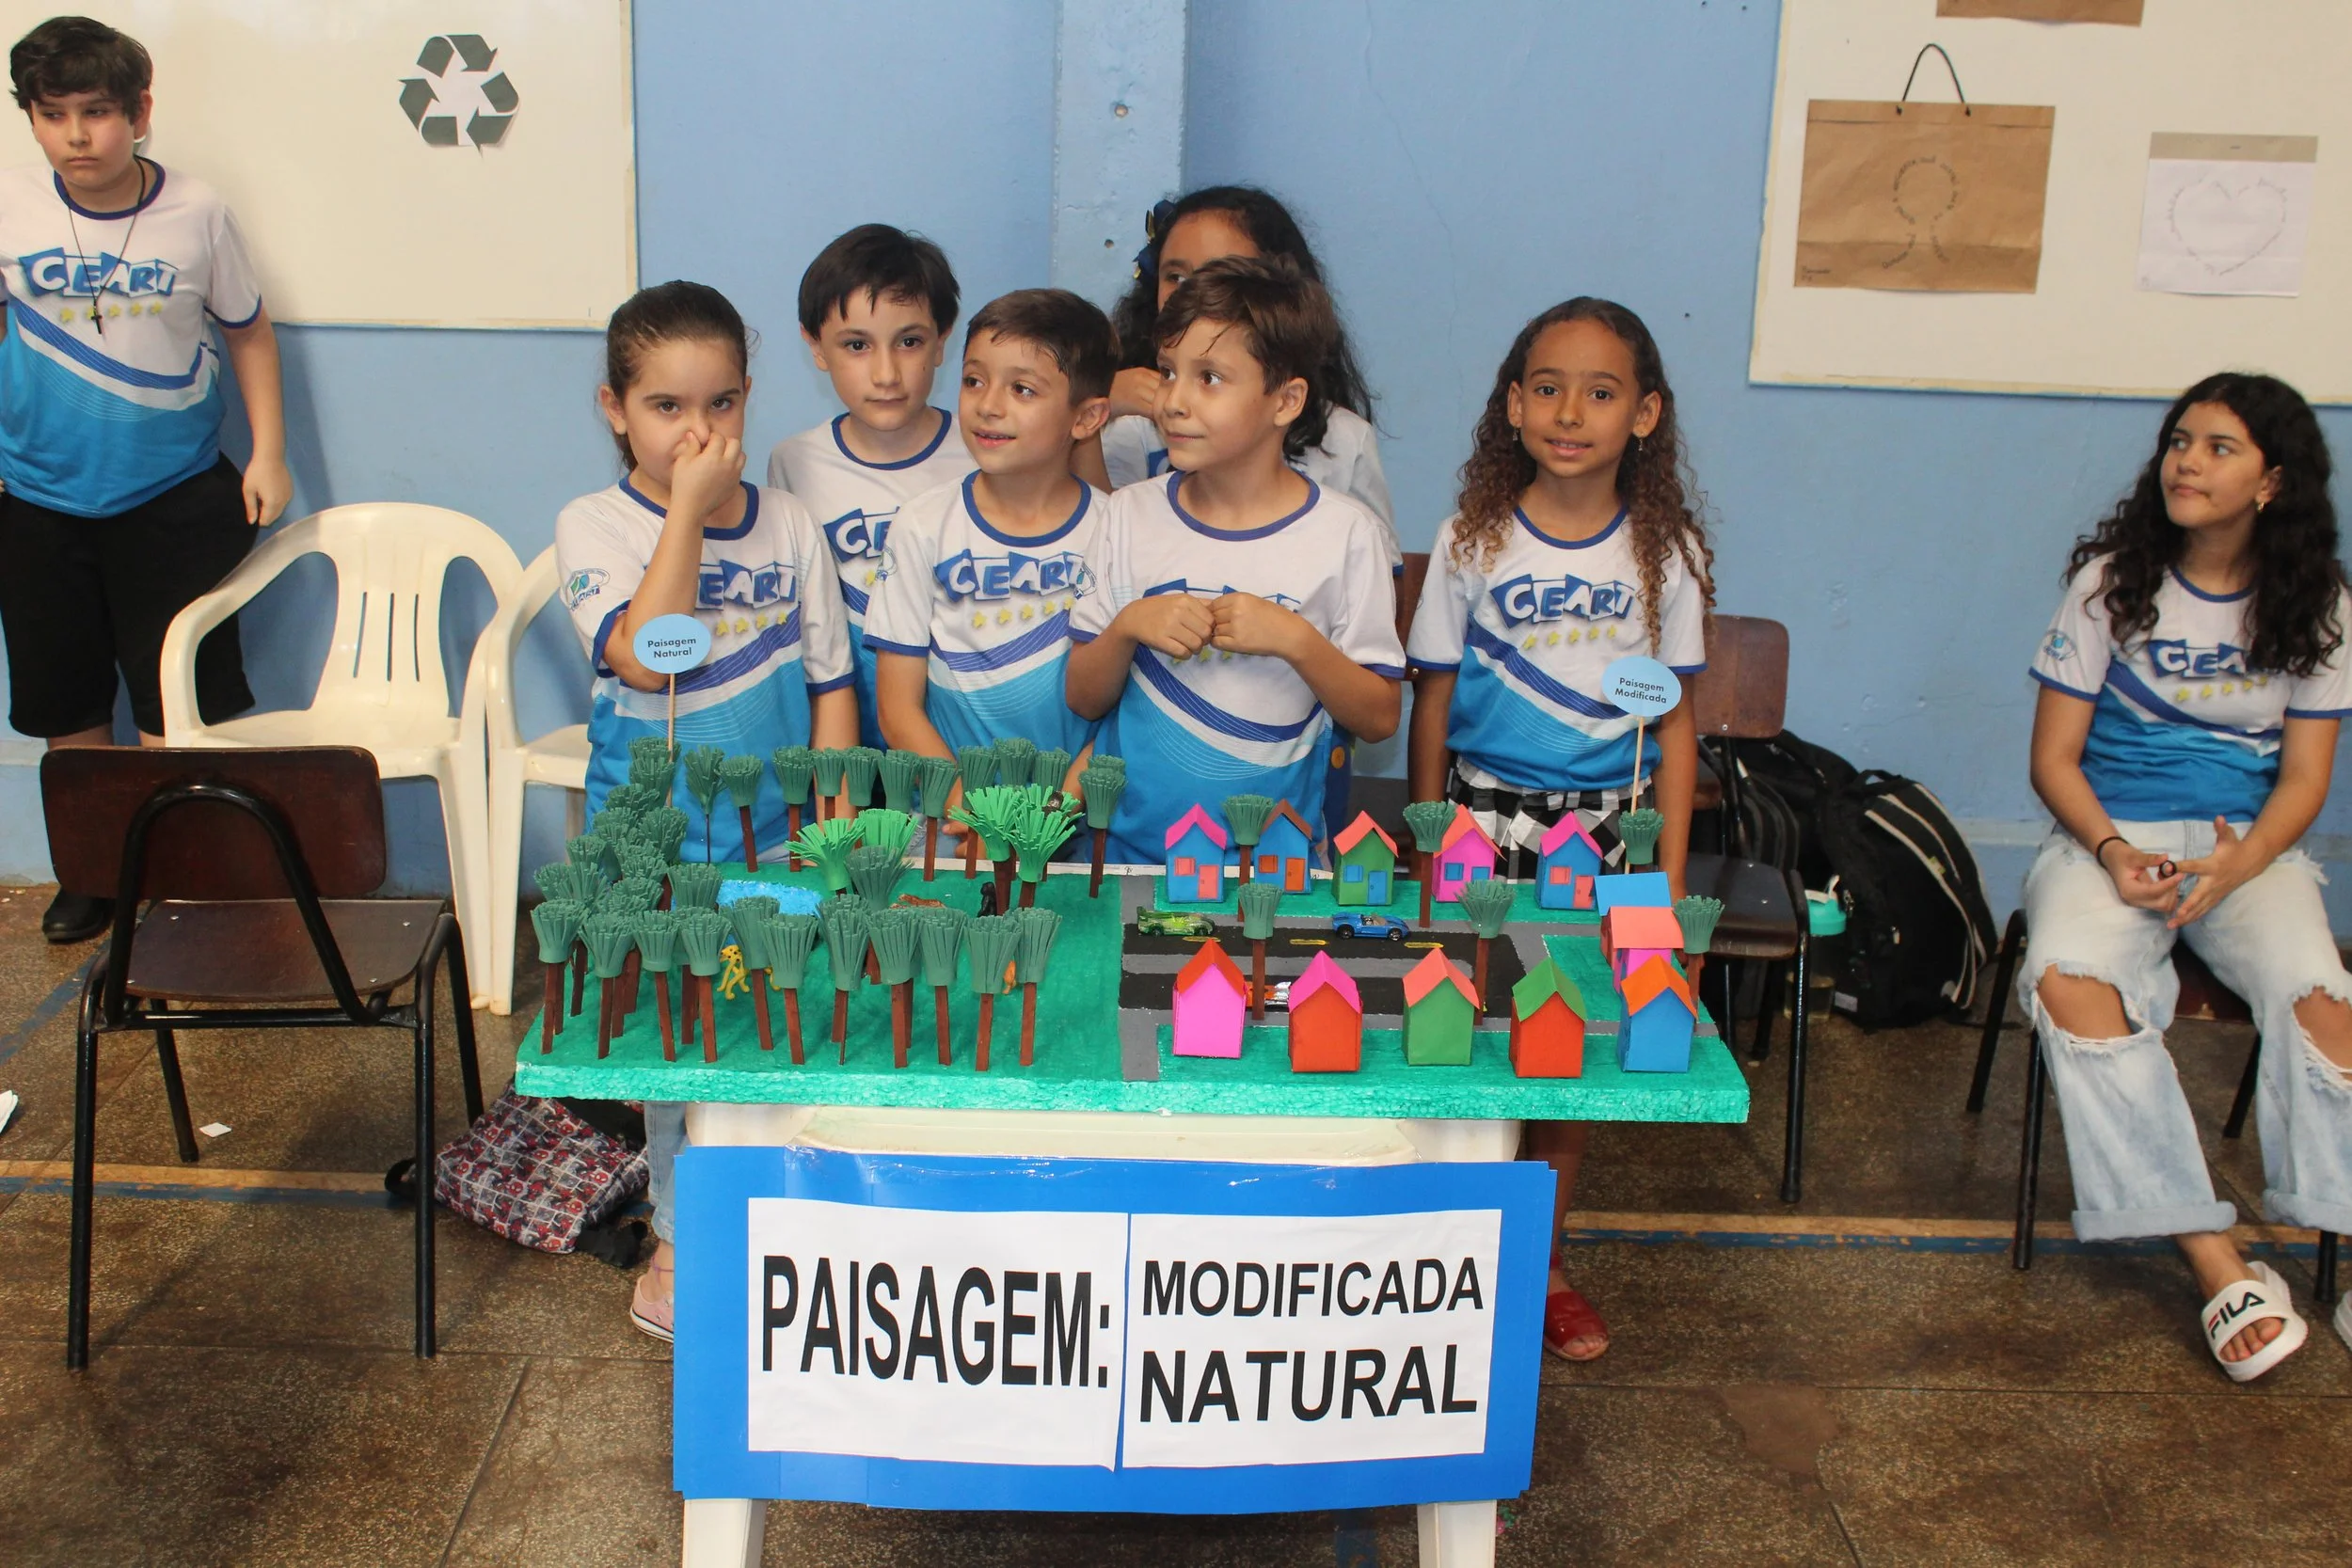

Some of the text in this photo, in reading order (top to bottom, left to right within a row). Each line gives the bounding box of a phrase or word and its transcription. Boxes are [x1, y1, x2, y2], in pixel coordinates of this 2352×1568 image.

[25, 250, 179, 295] CEART
[695, 567, 797, 608] EART
[944, 553, 1083, 596] CEART
[1503, 577, 1634, 624] CEART
[647, 638, 696, 648] Paisagem
[654, 647, 691, 658] Natural
[2153, 641, 2249, 676] CEA
[1614, 688, 1667, 704] Modificada
[1619, 677, 1664, 692] Paisagem
[1142, 1257, 1485, 1317] MODIFICADA
[762, 1255, 1110, 1388] PAISAGEM:
[2207, 1291, 2265, 1340] FILA
[1139, 1344, 1478, 1423] NATURAL
